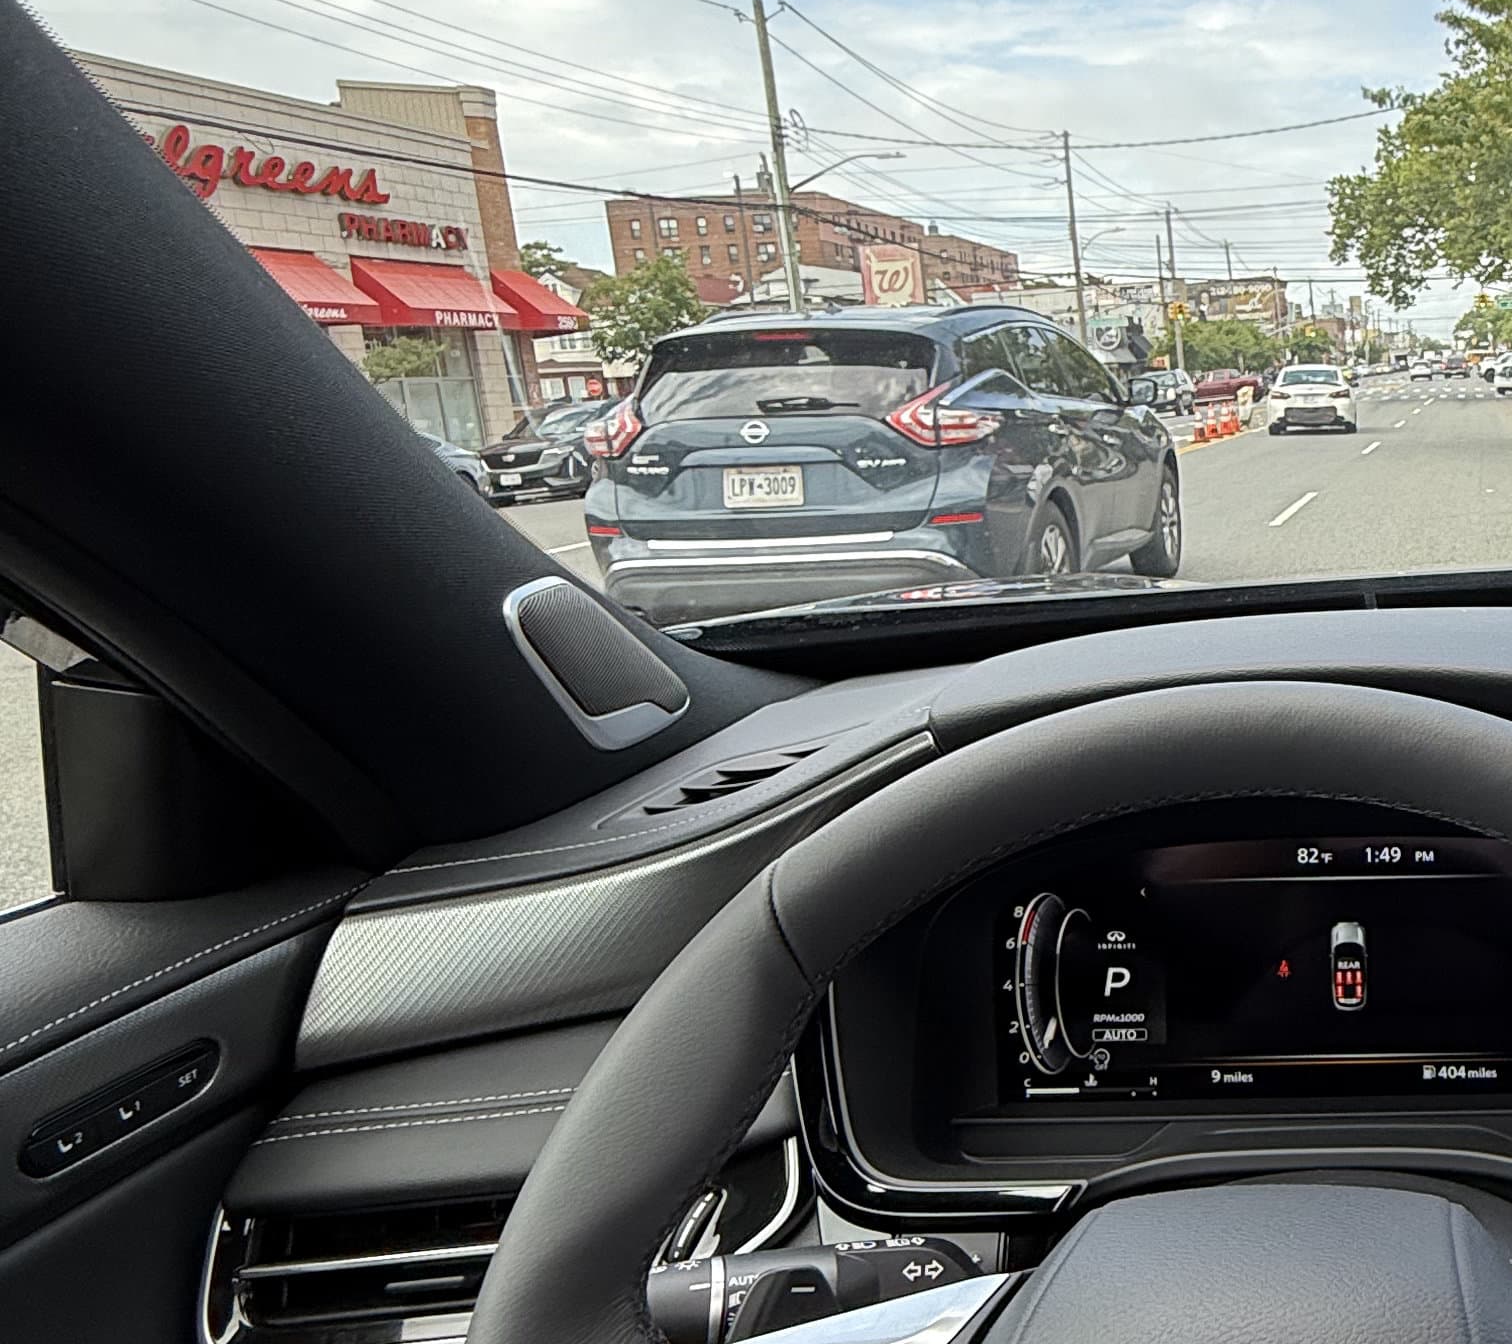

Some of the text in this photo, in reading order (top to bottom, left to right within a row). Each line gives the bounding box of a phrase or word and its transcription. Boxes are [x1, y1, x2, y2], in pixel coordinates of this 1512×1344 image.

[341, 213, 470, 250] PHARMACY
[435, 311, 500, 328] PHARMACY
[1365, 847, 1435, 863] 1:49 PM
[1013, 906, 1024, 918] 8
[1005, 937, 1016, 949] 6
[1003, 980, 1013, 991] 4
[1104, 967, 1131, 997] P
[1009, 1021, 1019, 1034] 2
[1103, 1029, 1137, 1040] AUTO
[1019, 1052, 1030, 1064] 0
[178, 1068, 198, 1088] SET
[1211, 1070, 1254, 1083] 9 miles
[1438, 1066, 1498, 1079] 404 miles
[1024, 1077, 1157, 1087] C H
